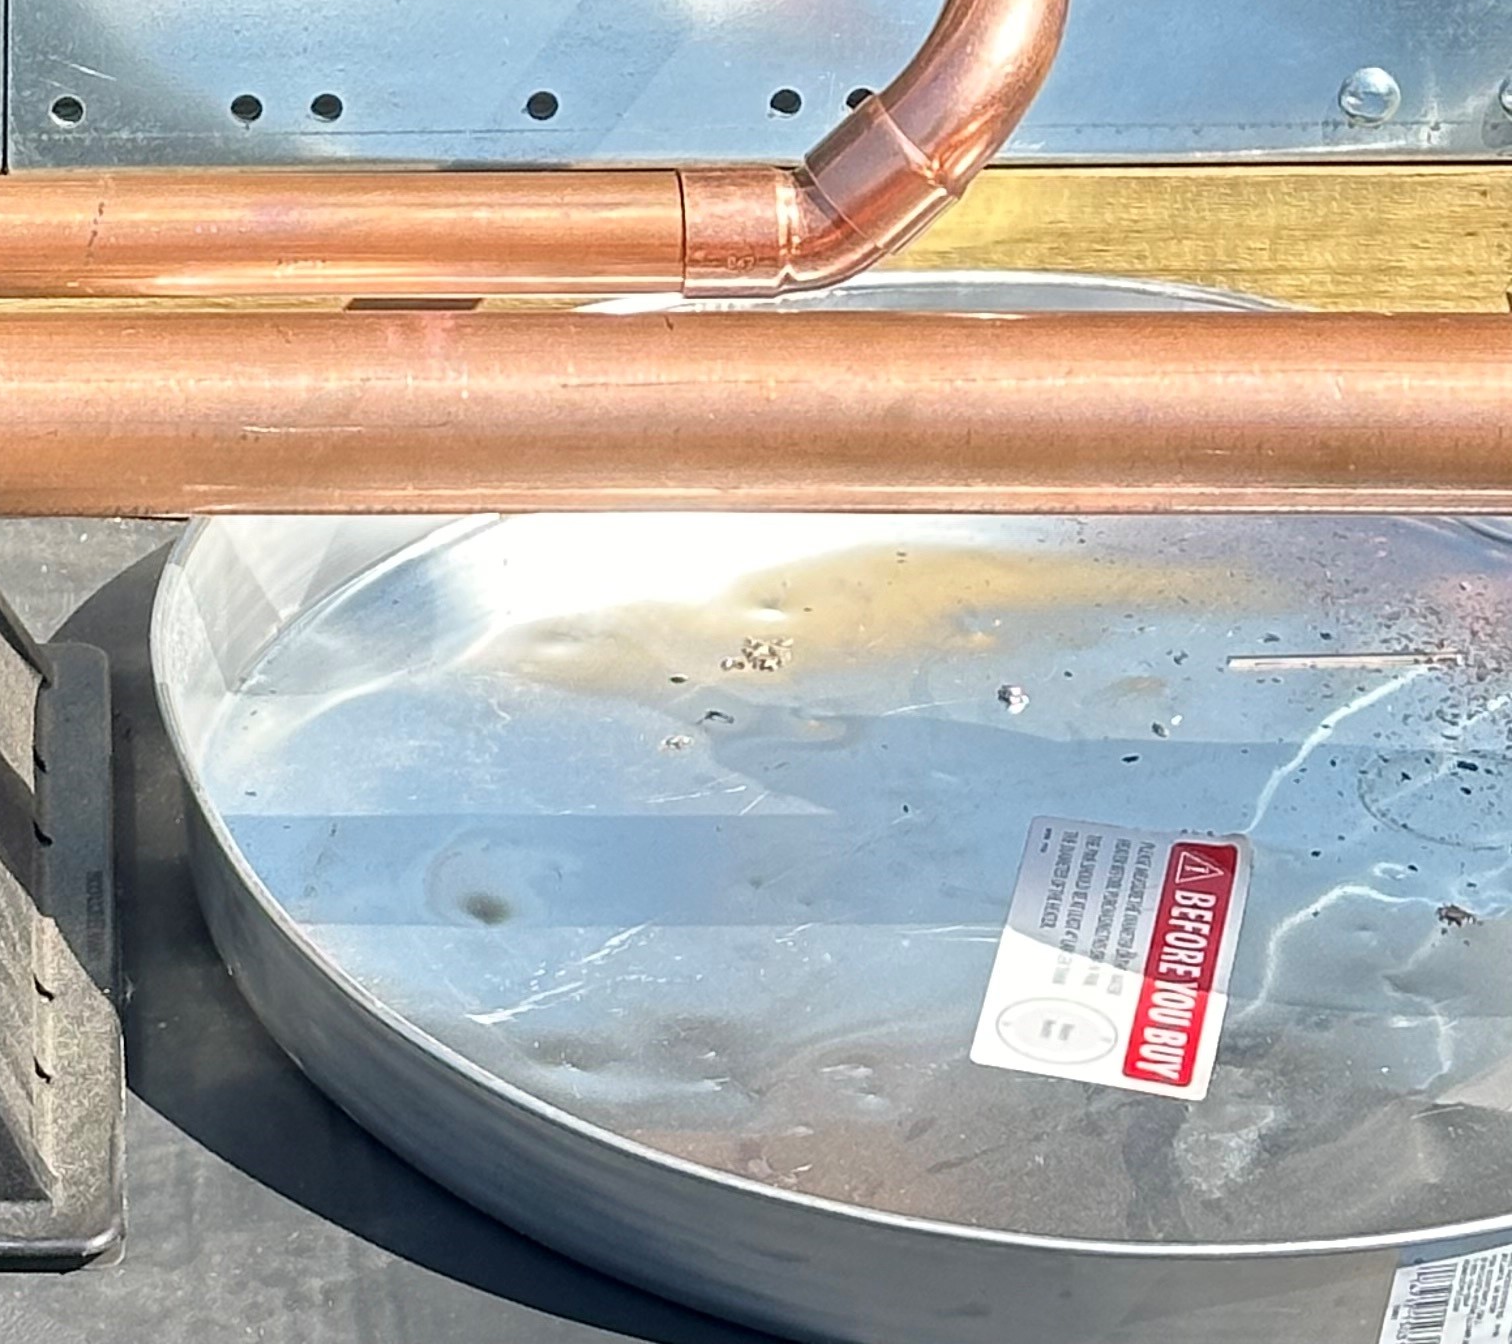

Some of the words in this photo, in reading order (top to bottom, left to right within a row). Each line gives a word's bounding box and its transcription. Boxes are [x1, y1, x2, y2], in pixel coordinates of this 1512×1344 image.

[1157, 890, 1216, 977] BEFORE
[1148, 979, 1198, 1025] YOU
[1135, 1027, 1187, 1080] BUY
